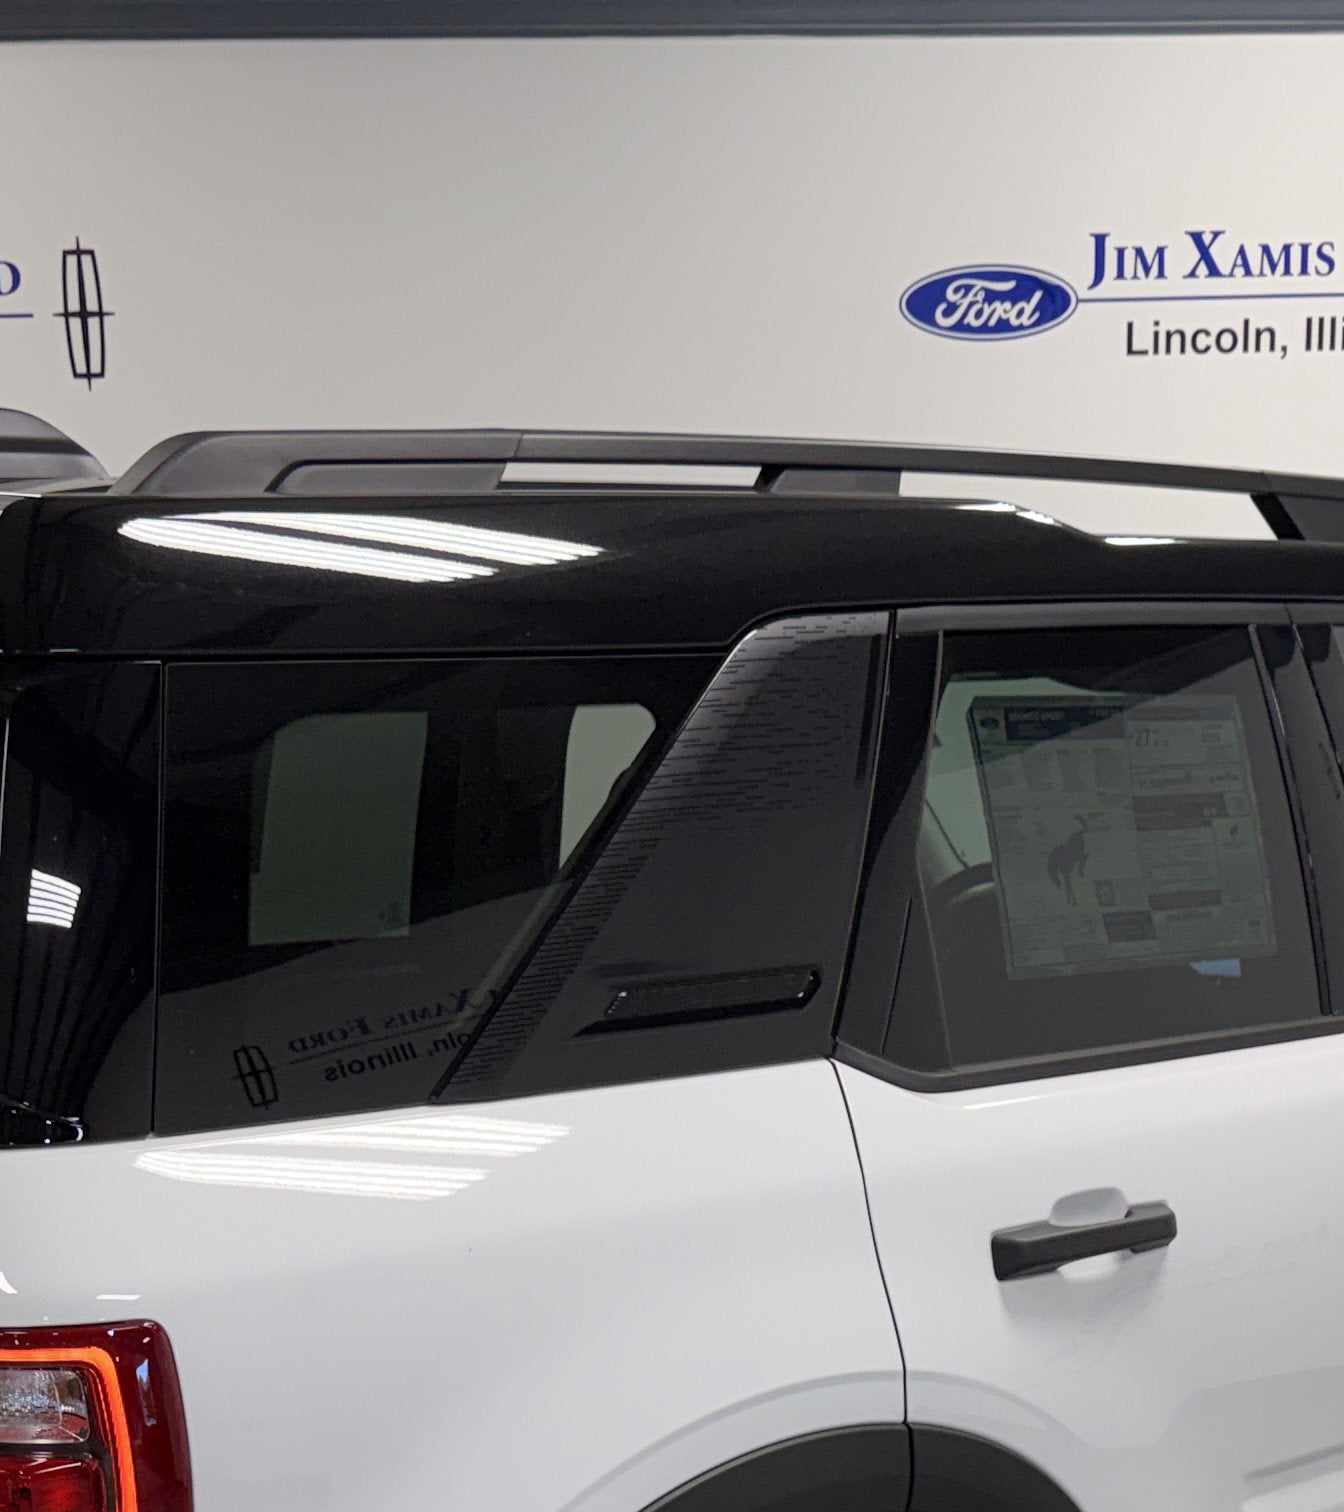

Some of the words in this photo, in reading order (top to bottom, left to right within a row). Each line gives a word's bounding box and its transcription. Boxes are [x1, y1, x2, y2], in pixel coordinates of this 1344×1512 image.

[1087, 232, 1168, 290] JIM
[1183, 231, 1336, 279] XAMIS
[935, 280, 1040, 329] Ford
[1125, 317, 1288, 360] Lincoln,
